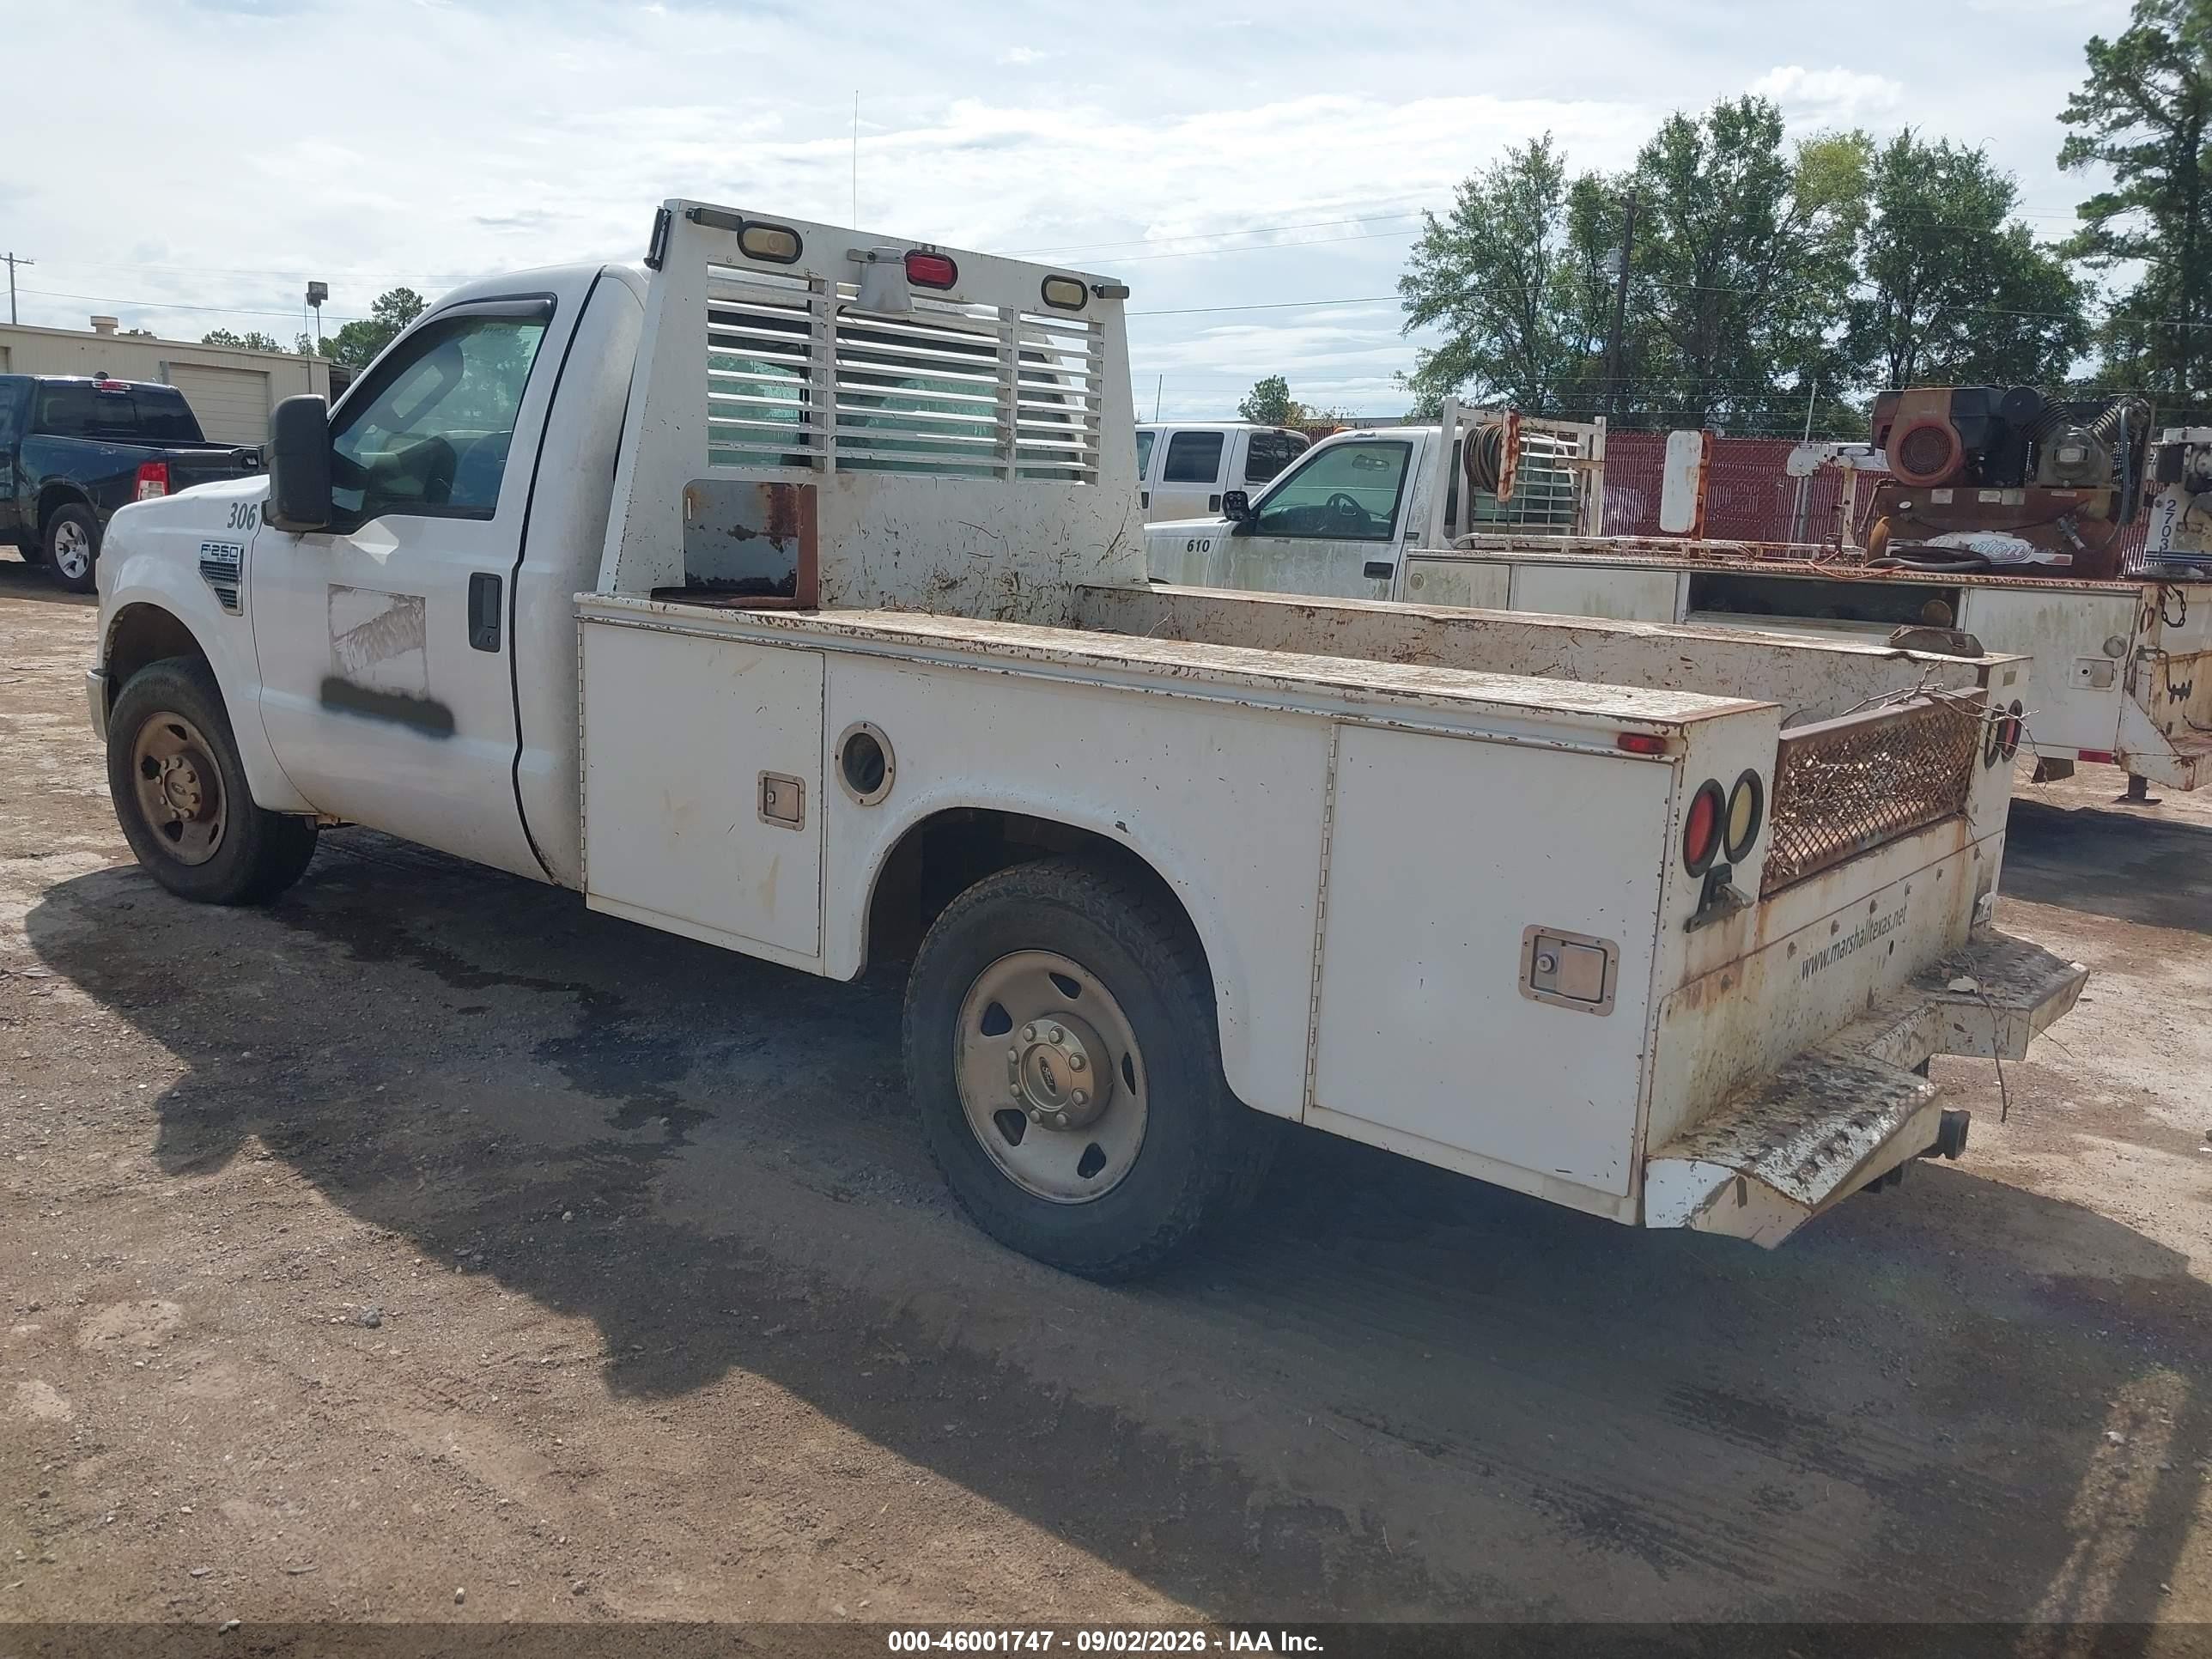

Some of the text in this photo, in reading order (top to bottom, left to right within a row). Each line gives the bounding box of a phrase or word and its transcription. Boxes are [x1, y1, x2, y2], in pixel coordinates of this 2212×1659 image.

[227, 502, 258, 531] 306
[2160, 499, 2177, 551] 2703
[1187, 539, 1210, 553] 610
[1802, 902, 1908, 982] www.marshalltexas.net
